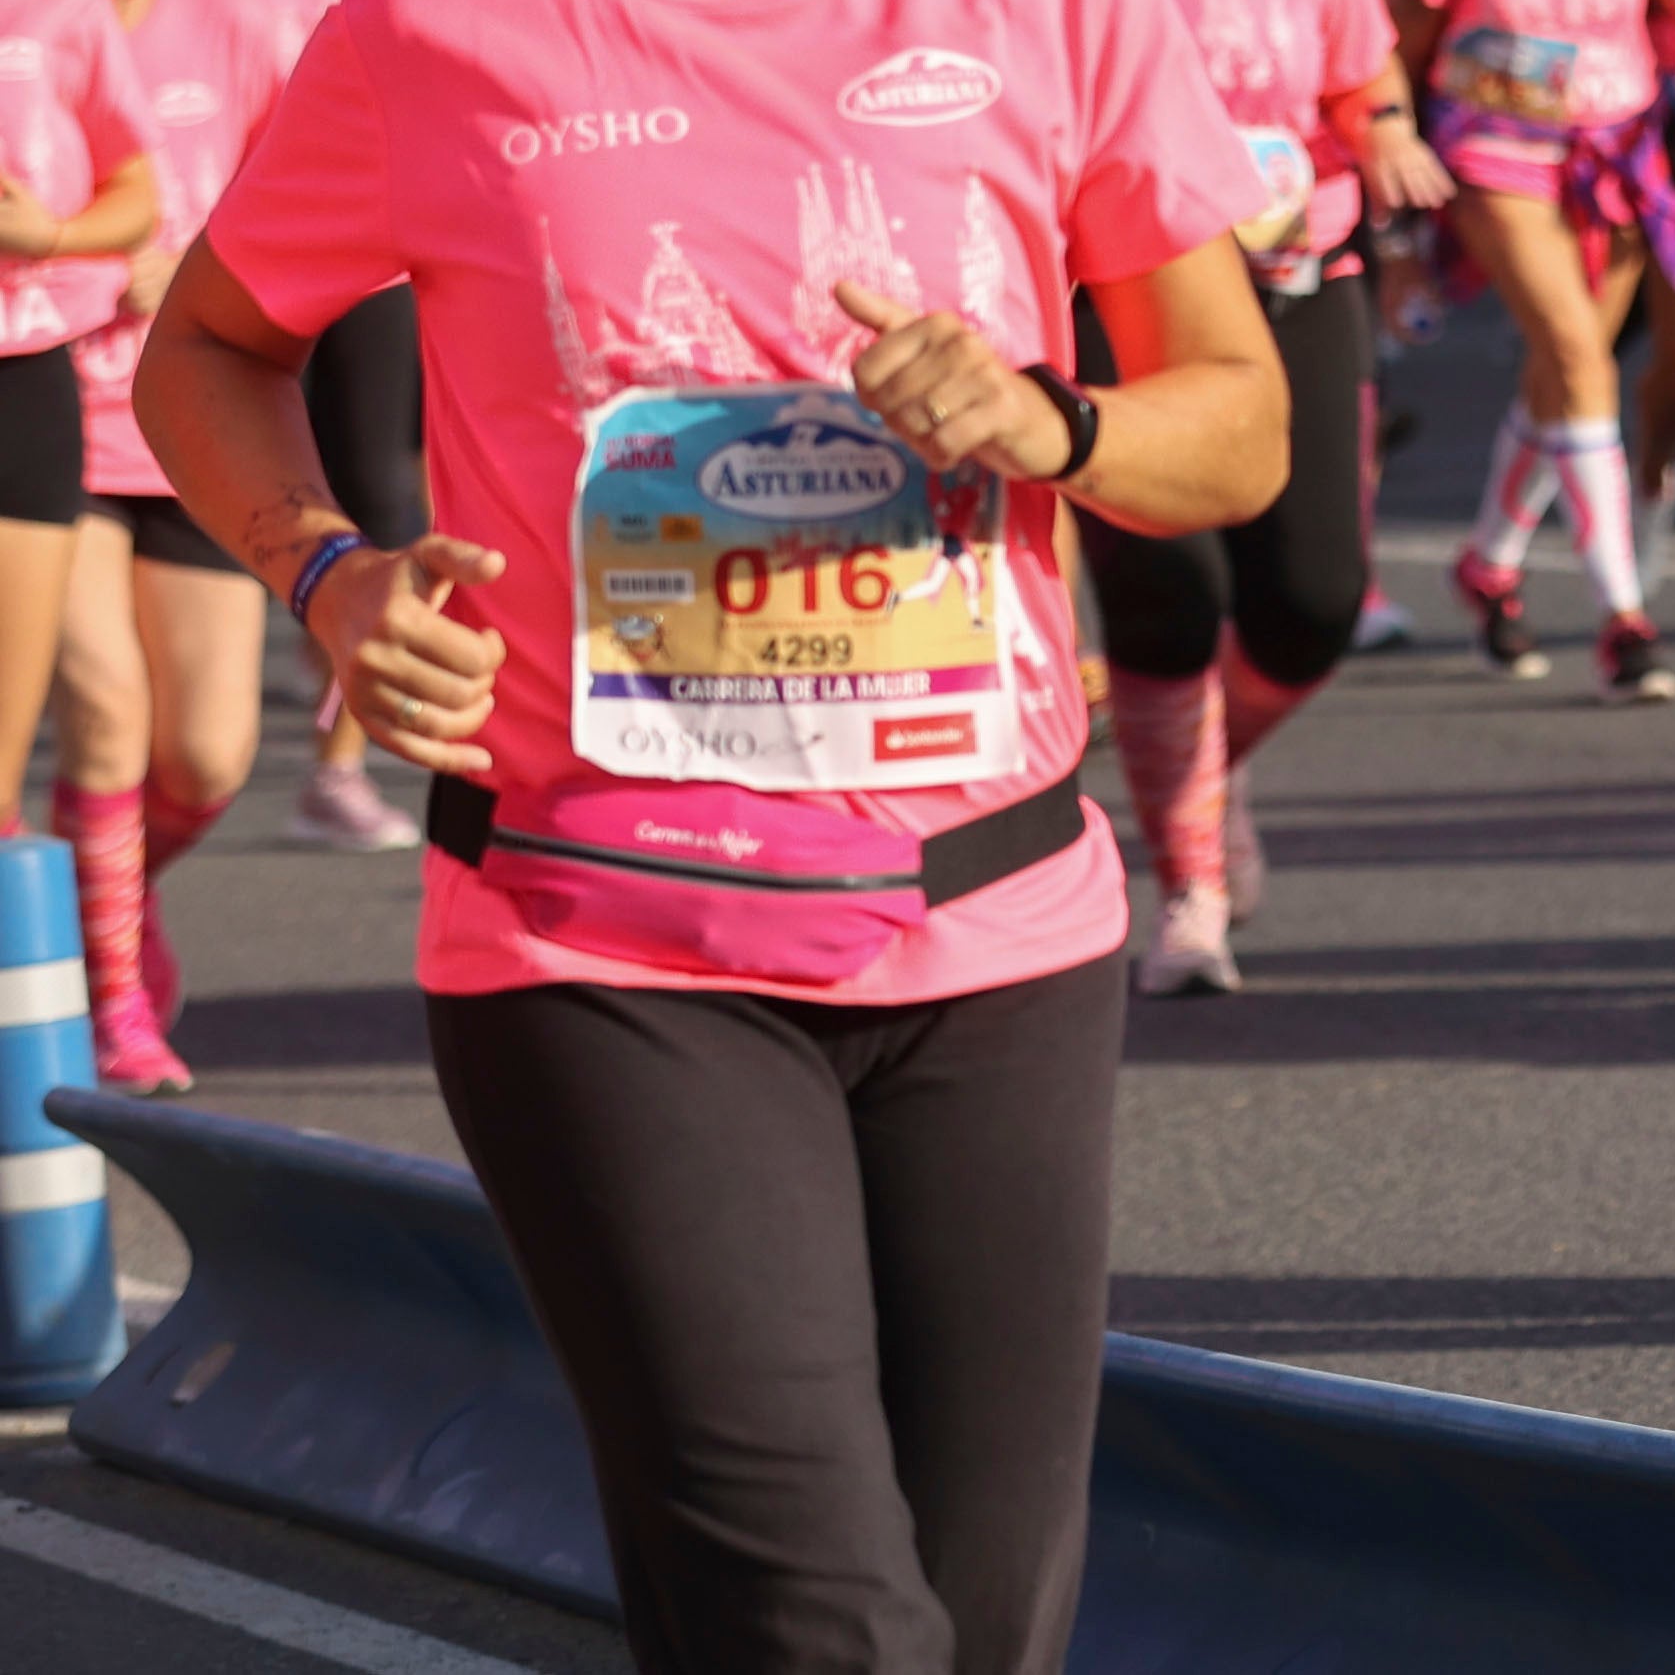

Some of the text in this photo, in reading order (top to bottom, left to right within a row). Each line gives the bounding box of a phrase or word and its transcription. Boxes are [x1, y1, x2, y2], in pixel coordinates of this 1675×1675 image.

[503, 106, 690, 164] OYSHO
[714, 461, 893, 498] ASTURIANA
[714, 544, 893, 615] 016
[759, 633, 854, 666] 4299
[670, 674, 778, 702] CARRERA
[783, 674, 817, 700] DE
[821, 673, 854, 700] LA
[618, 726, 758, 760] OYSHO
